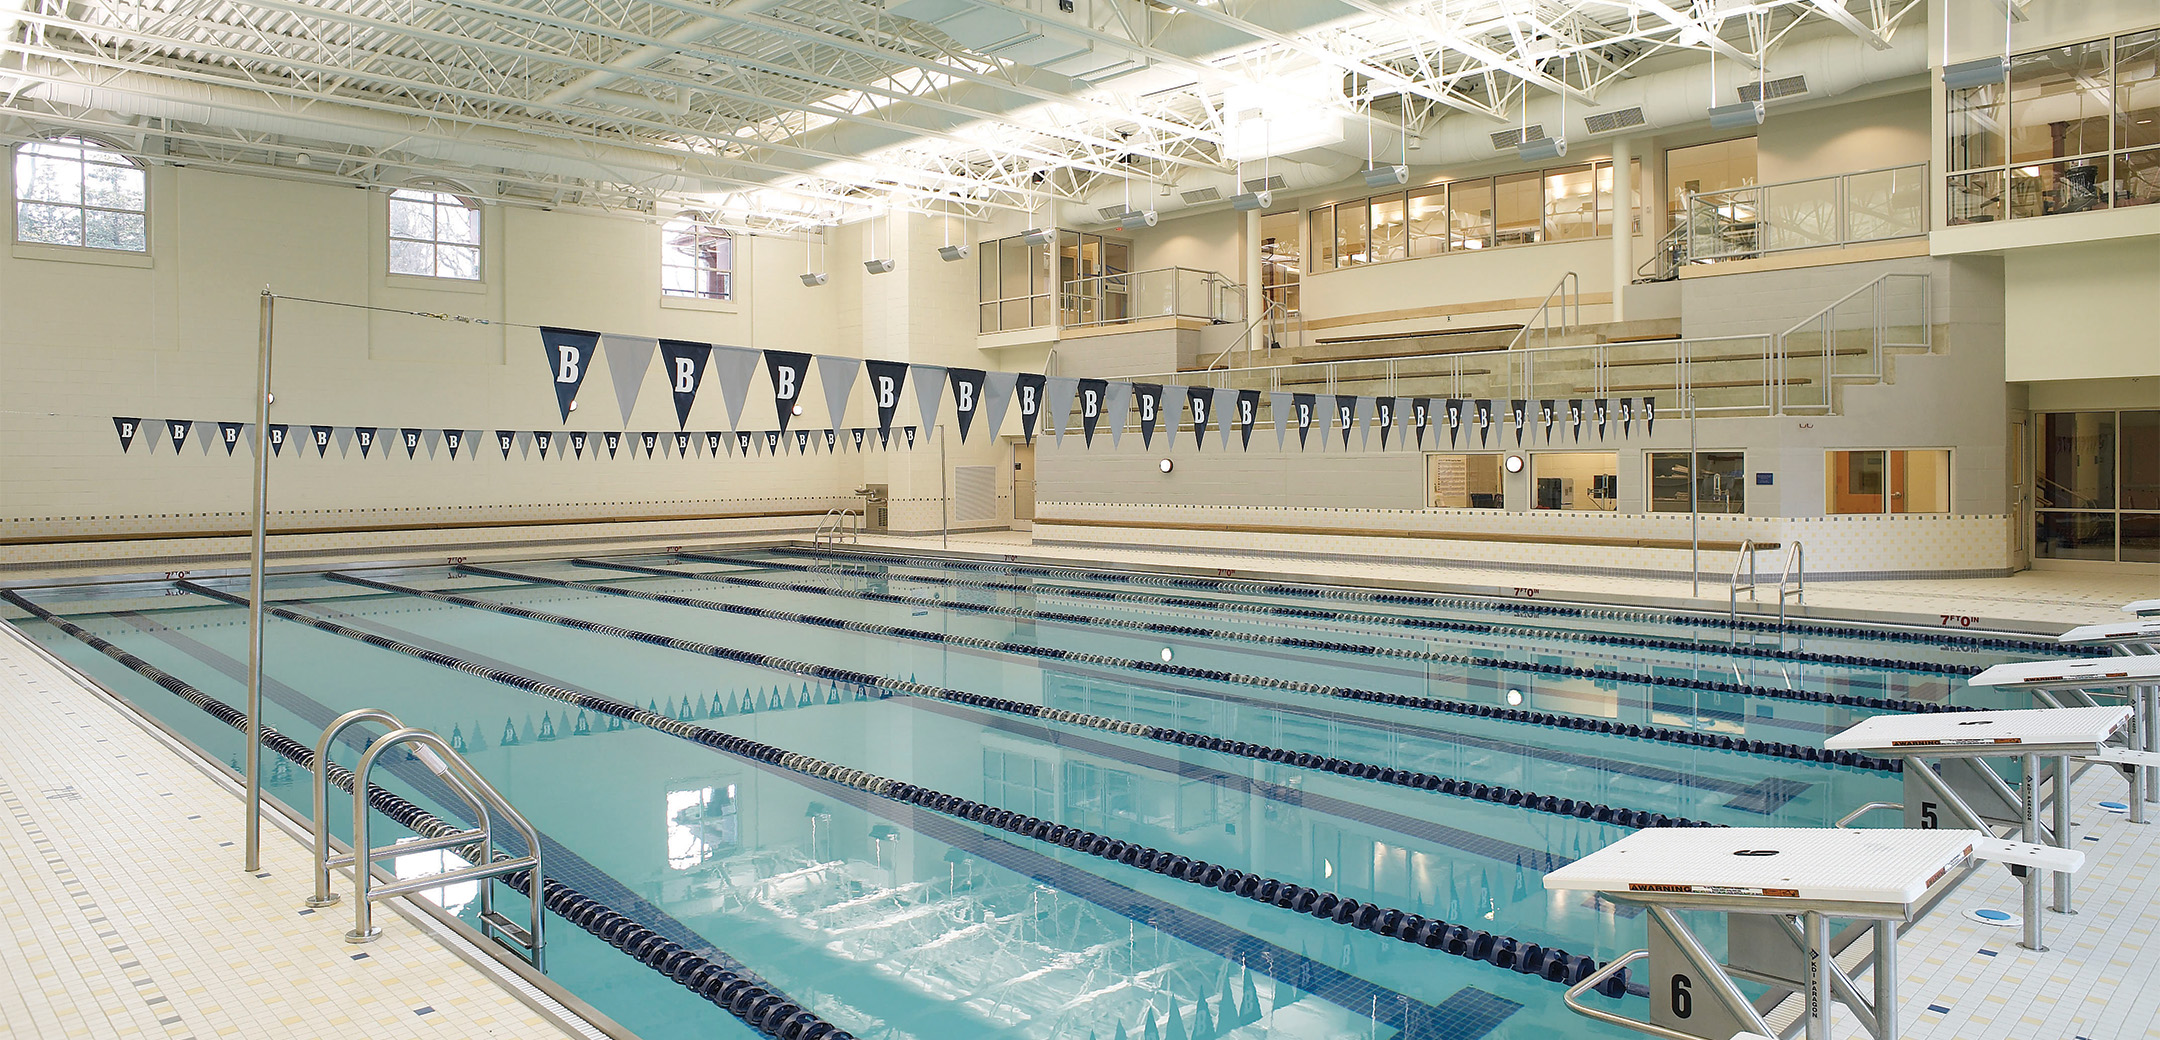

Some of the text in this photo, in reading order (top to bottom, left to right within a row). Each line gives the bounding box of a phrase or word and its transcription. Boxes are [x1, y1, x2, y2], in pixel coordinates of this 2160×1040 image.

[557, 346, 579, 383] B
[675, 357, 694, 392] B
[777, 366, 795, 399] B
[879, 376, 894, 407] B
[959, 382, 972, 411] B
[1023, 386, 1035, 414] B
[1085, 390, 1097, 417] B
[1142, 395, 1153, 420] B
[1194, 398, 1204, 423] B
[1647, 404, 1653, 420] B
[1242, 401, 1251, 424] B
[1300, 405, 1309, 427] B
[1341, 406, 1351, 429] B
[1381, 405, 1389, 427] B
[1417, 406, 1424, 427] B
[1450, 407, 1458, 428] B
[1481, 408, 1488, 428] B
[1516, 410, 1522, 428] B
[1544, 408, 1551, 427] B
[1572, 407, 1579, 426] B
[1598, 407, 1604, 425] B
[1623, 404, 1629, 421] B
[122, 423, 132, 437] B
[174, 425, 184, 439] B
[226, 428, 235, 442] B
[272, 430, 281, 443] B
[318, 432, 326, 445] B
[855, 432, 861, 443] B
[908, 431, 913, 440] B
[361, 433, 370, 445] B
[408, 434, 416, 447] B
[450, 436, 457, 448] B
[502, 437, 509, 449] B
[540, 437, 547, 449] B
[575, 437, 582, 449] B
[609, 437, 616, 448] B
[647, 437, 653, 448] B
[680, 437, 686, 448] B
[711, 437, 717, 448] B
[741, 436, 747, 447] B
[770, 435, 776, 445] B
[800, 435, 805, 445] B
[828, 434, 834, 444] B
[1921, 801, 1938, 829] 5
[1671, 973, 1692, 1020] 6
